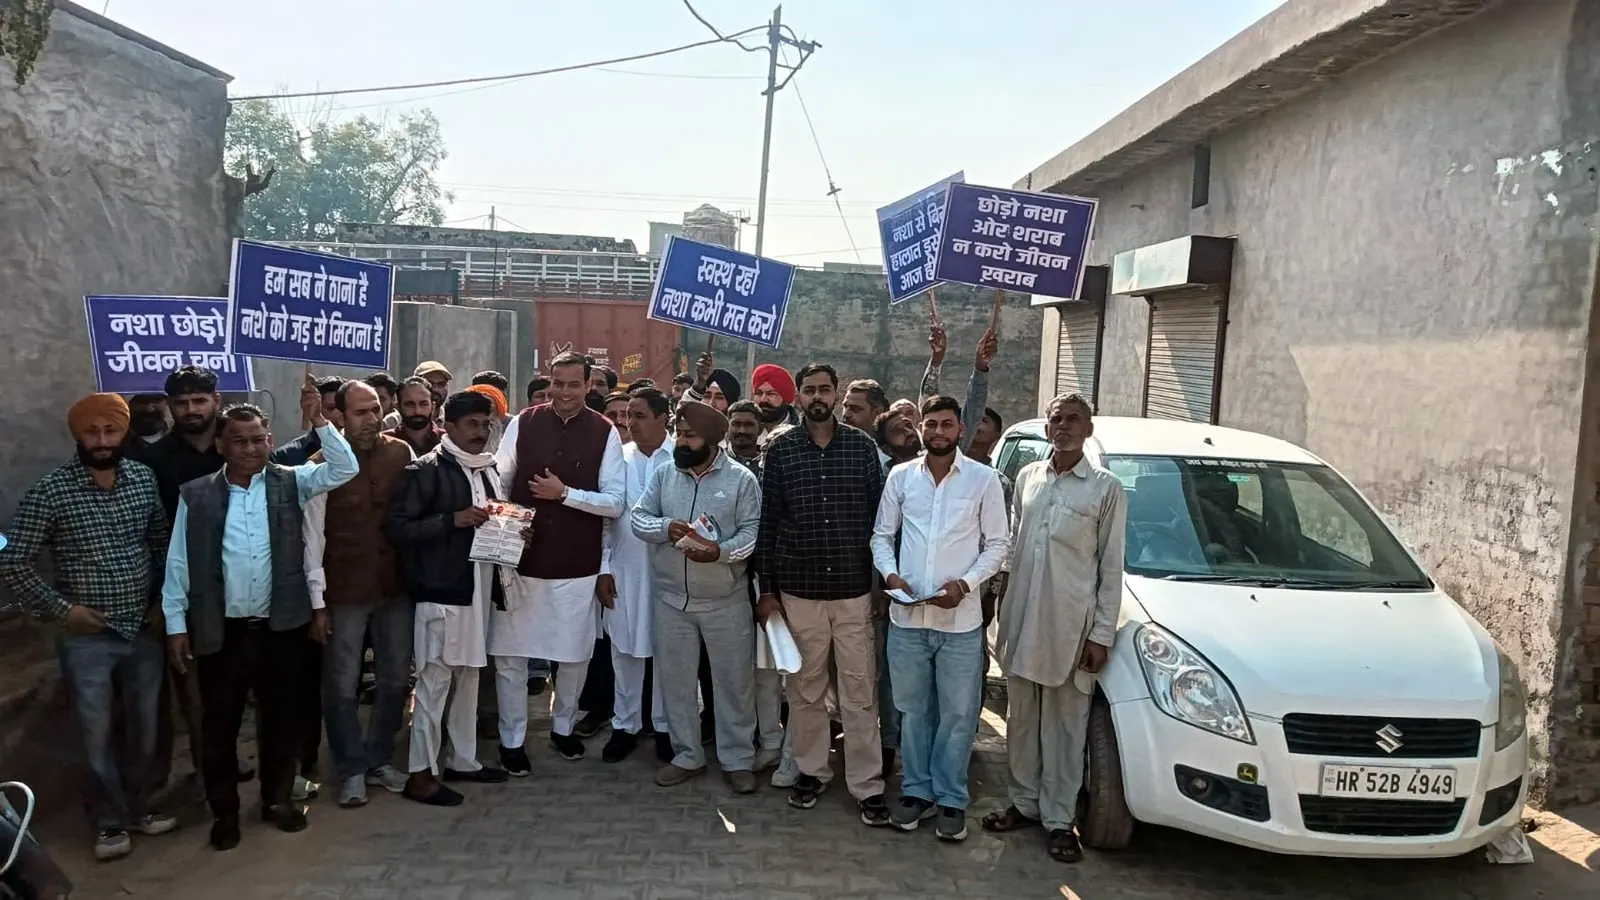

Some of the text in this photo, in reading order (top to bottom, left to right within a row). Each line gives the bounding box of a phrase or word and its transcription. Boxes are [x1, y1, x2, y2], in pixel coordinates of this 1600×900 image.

[977, 194, 1068, 224] छोड़ो नशा
[891, 220, 914, 243] नशा
[914, 209, 926, 233] से
[1012, 225, 1066, 247] शराब
[890, 241, 922, 272] हालात
[952, 238, 1071, 271] न करो जीवन
[264, 264, 369, 307] हम सब ने ठाना है
[697, 255, 760, 297] स्वस्थ रहो
[900, 265, 923, 291] आज
[108, 306, 225, 345] नशा छोड़ो
[240, 299, 384, 352] नशे को जड़ से मिटाना है
[660, 287, 777, 341] नशा कभी मत करो
[104, 340, 183, 373] जीवन
[1335, 770, 1453, 795] HR 52B 4949
